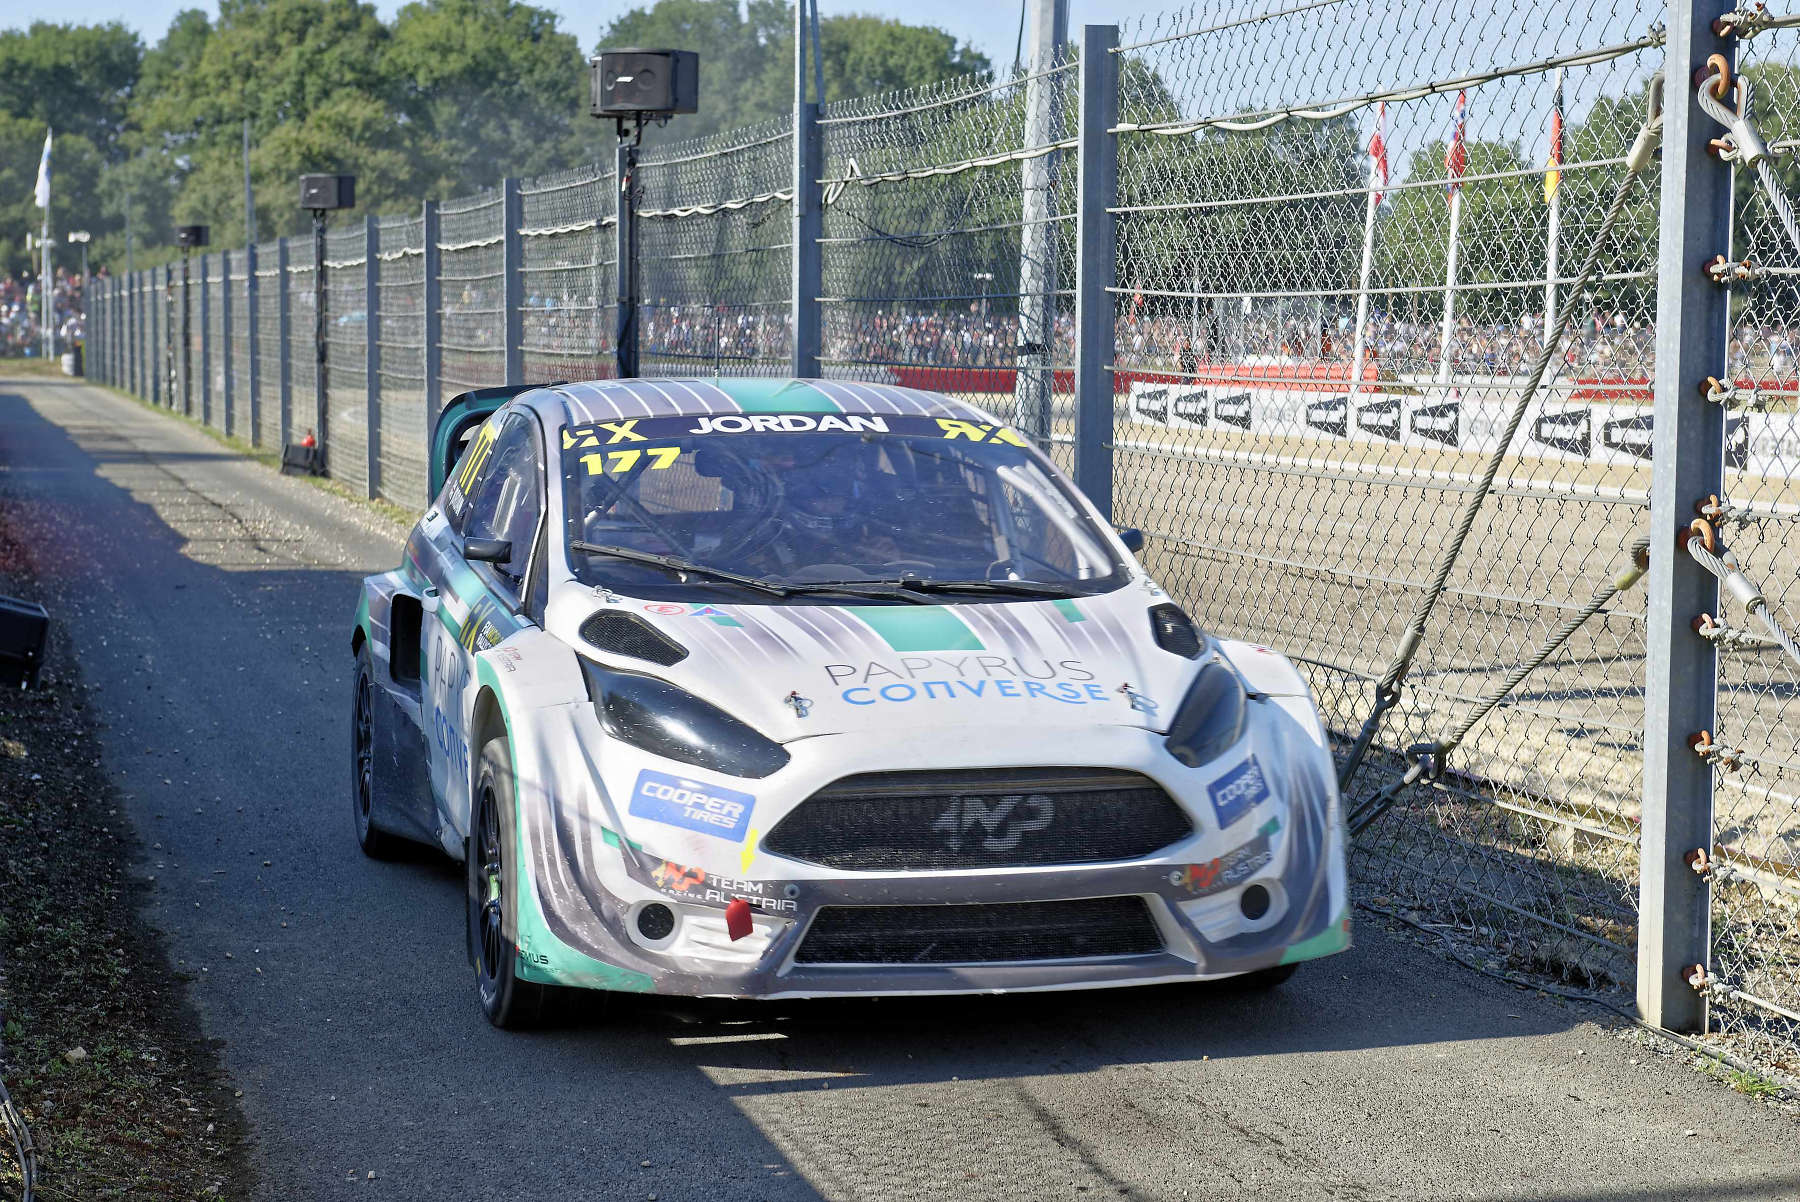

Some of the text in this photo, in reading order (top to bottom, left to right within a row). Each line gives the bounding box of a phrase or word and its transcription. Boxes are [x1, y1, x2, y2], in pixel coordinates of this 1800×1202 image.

[688, 414, 891, 435] JORDAN
[579, 446, 681, 476] 177
[824, 655, 1096, 687] PAPYRUS
[841, 679, 1110, 706] CONVERSE
[641, 781, 745, 819] COOPER
[683, 806, 739, 830] TIRES
[709, 874, 764, 895] TEAM
